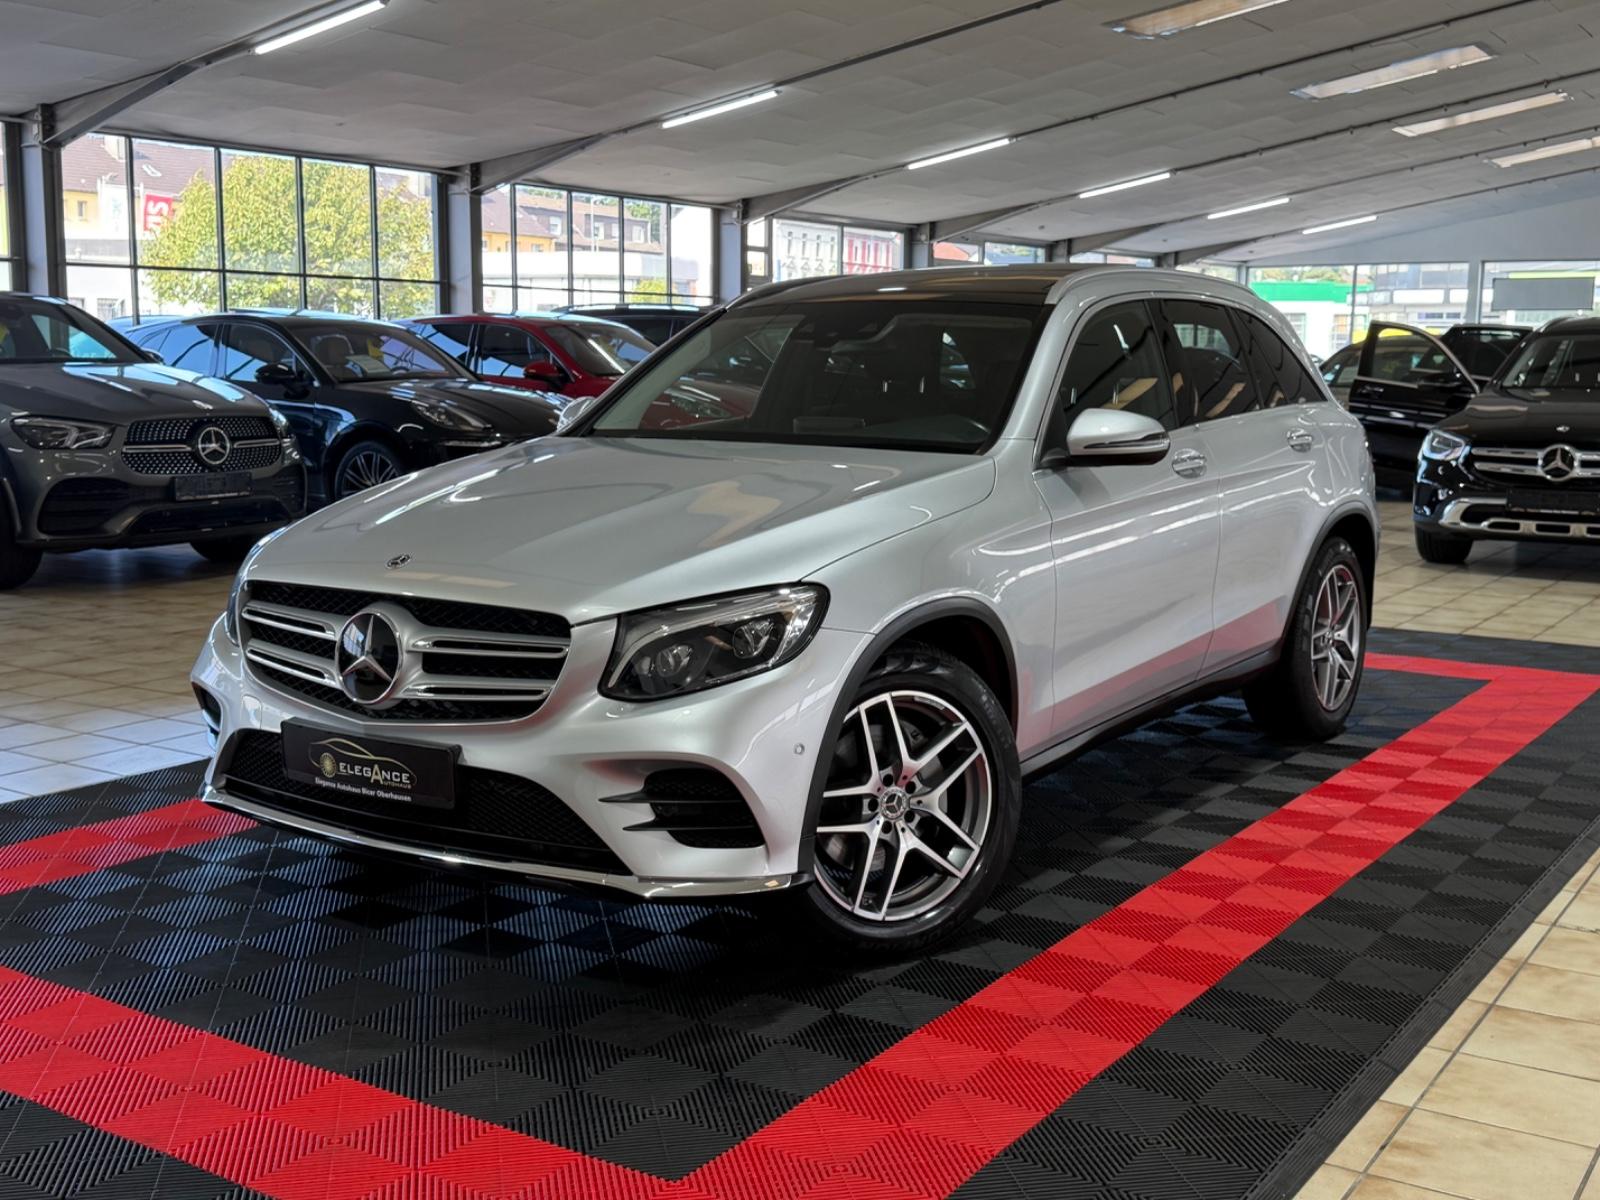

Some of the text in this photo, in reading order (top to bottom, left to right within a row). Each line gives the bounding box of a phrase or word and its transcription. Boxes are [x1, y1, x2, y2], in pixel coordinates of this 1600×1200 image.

[339, 762, 410, 785] ELEGANCE
[315, 777, 336, 788] Elegance
[336, 782, 361, 793] Autohaus
[376, 790, 412, 802] Oberhausen
